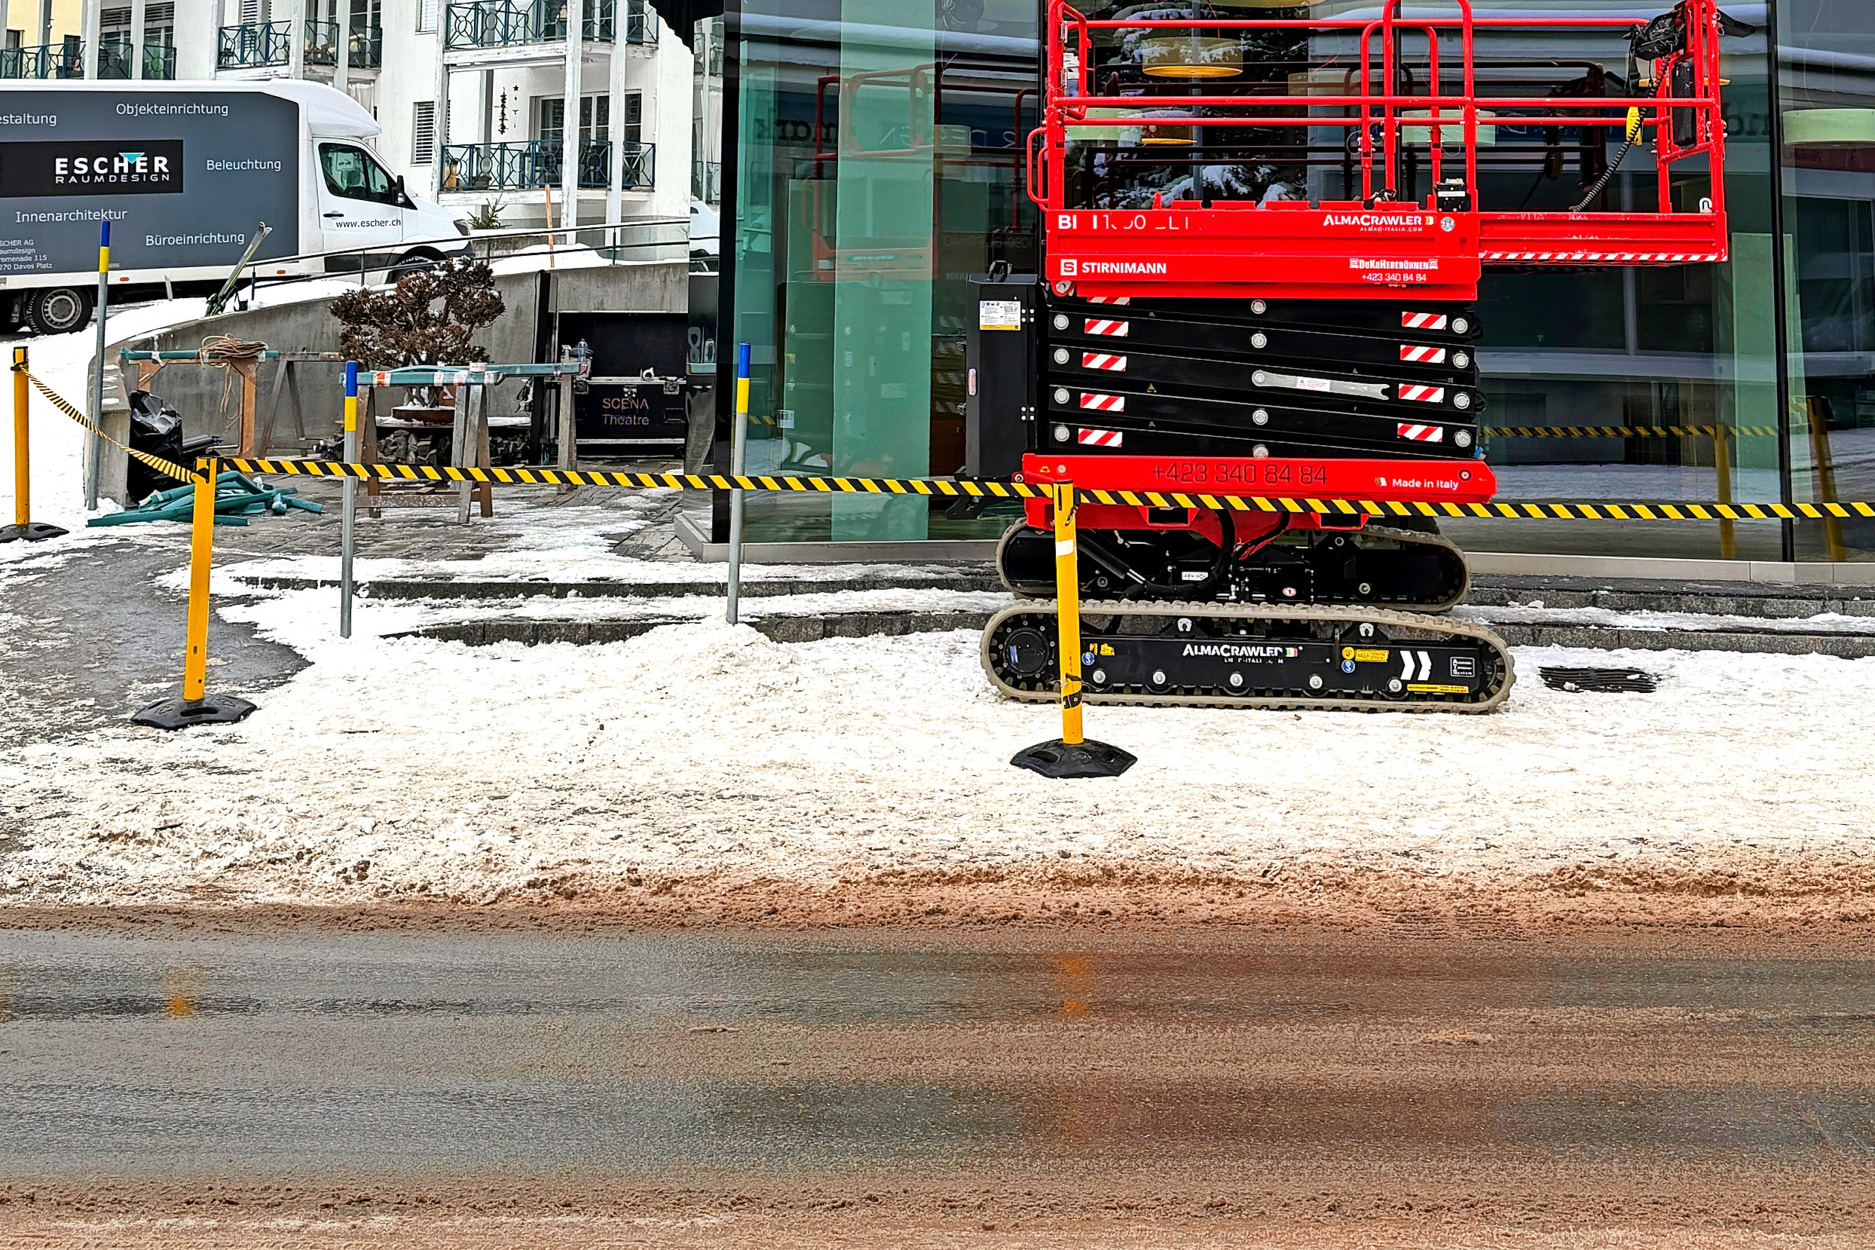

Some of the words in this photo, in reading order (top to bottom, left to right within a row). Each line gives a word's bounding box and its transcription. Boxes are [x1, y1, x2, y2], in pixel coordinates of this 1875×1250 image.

[116, 103, 229, 117] Objekteinrichtung
[55, 156, 170, 175] ESCHER
[206, 159, 282, 172] Beleuchtung
[55, 174, 170, 184] RAUMDESIGN
[15, 209, 128, 223] Innenarchitektur
[335, 218, 402, 228] www.escher.ch
[146, 233, 245, 247] Büroeinrichtung
[1082, 262, 1167, 274] STIRNIMANN
[1385, 273, 1401, 282] 340
[1403, 273, 1414, 282] 84
[1416, 273, 1427, 282] 84
[602, 398, 649, 410] SCENA
[1152, 462, 1208, 484] +423
[1215, 463, 1257, 484] 340
[1264, 463, 1292, 485] 84
[1300, 464, 1328, 486] 84
[1392, 478, 1422, 489] Made
[1424, 478, 1434, 489] in
[1436, 479, 1459, 491] Italy
